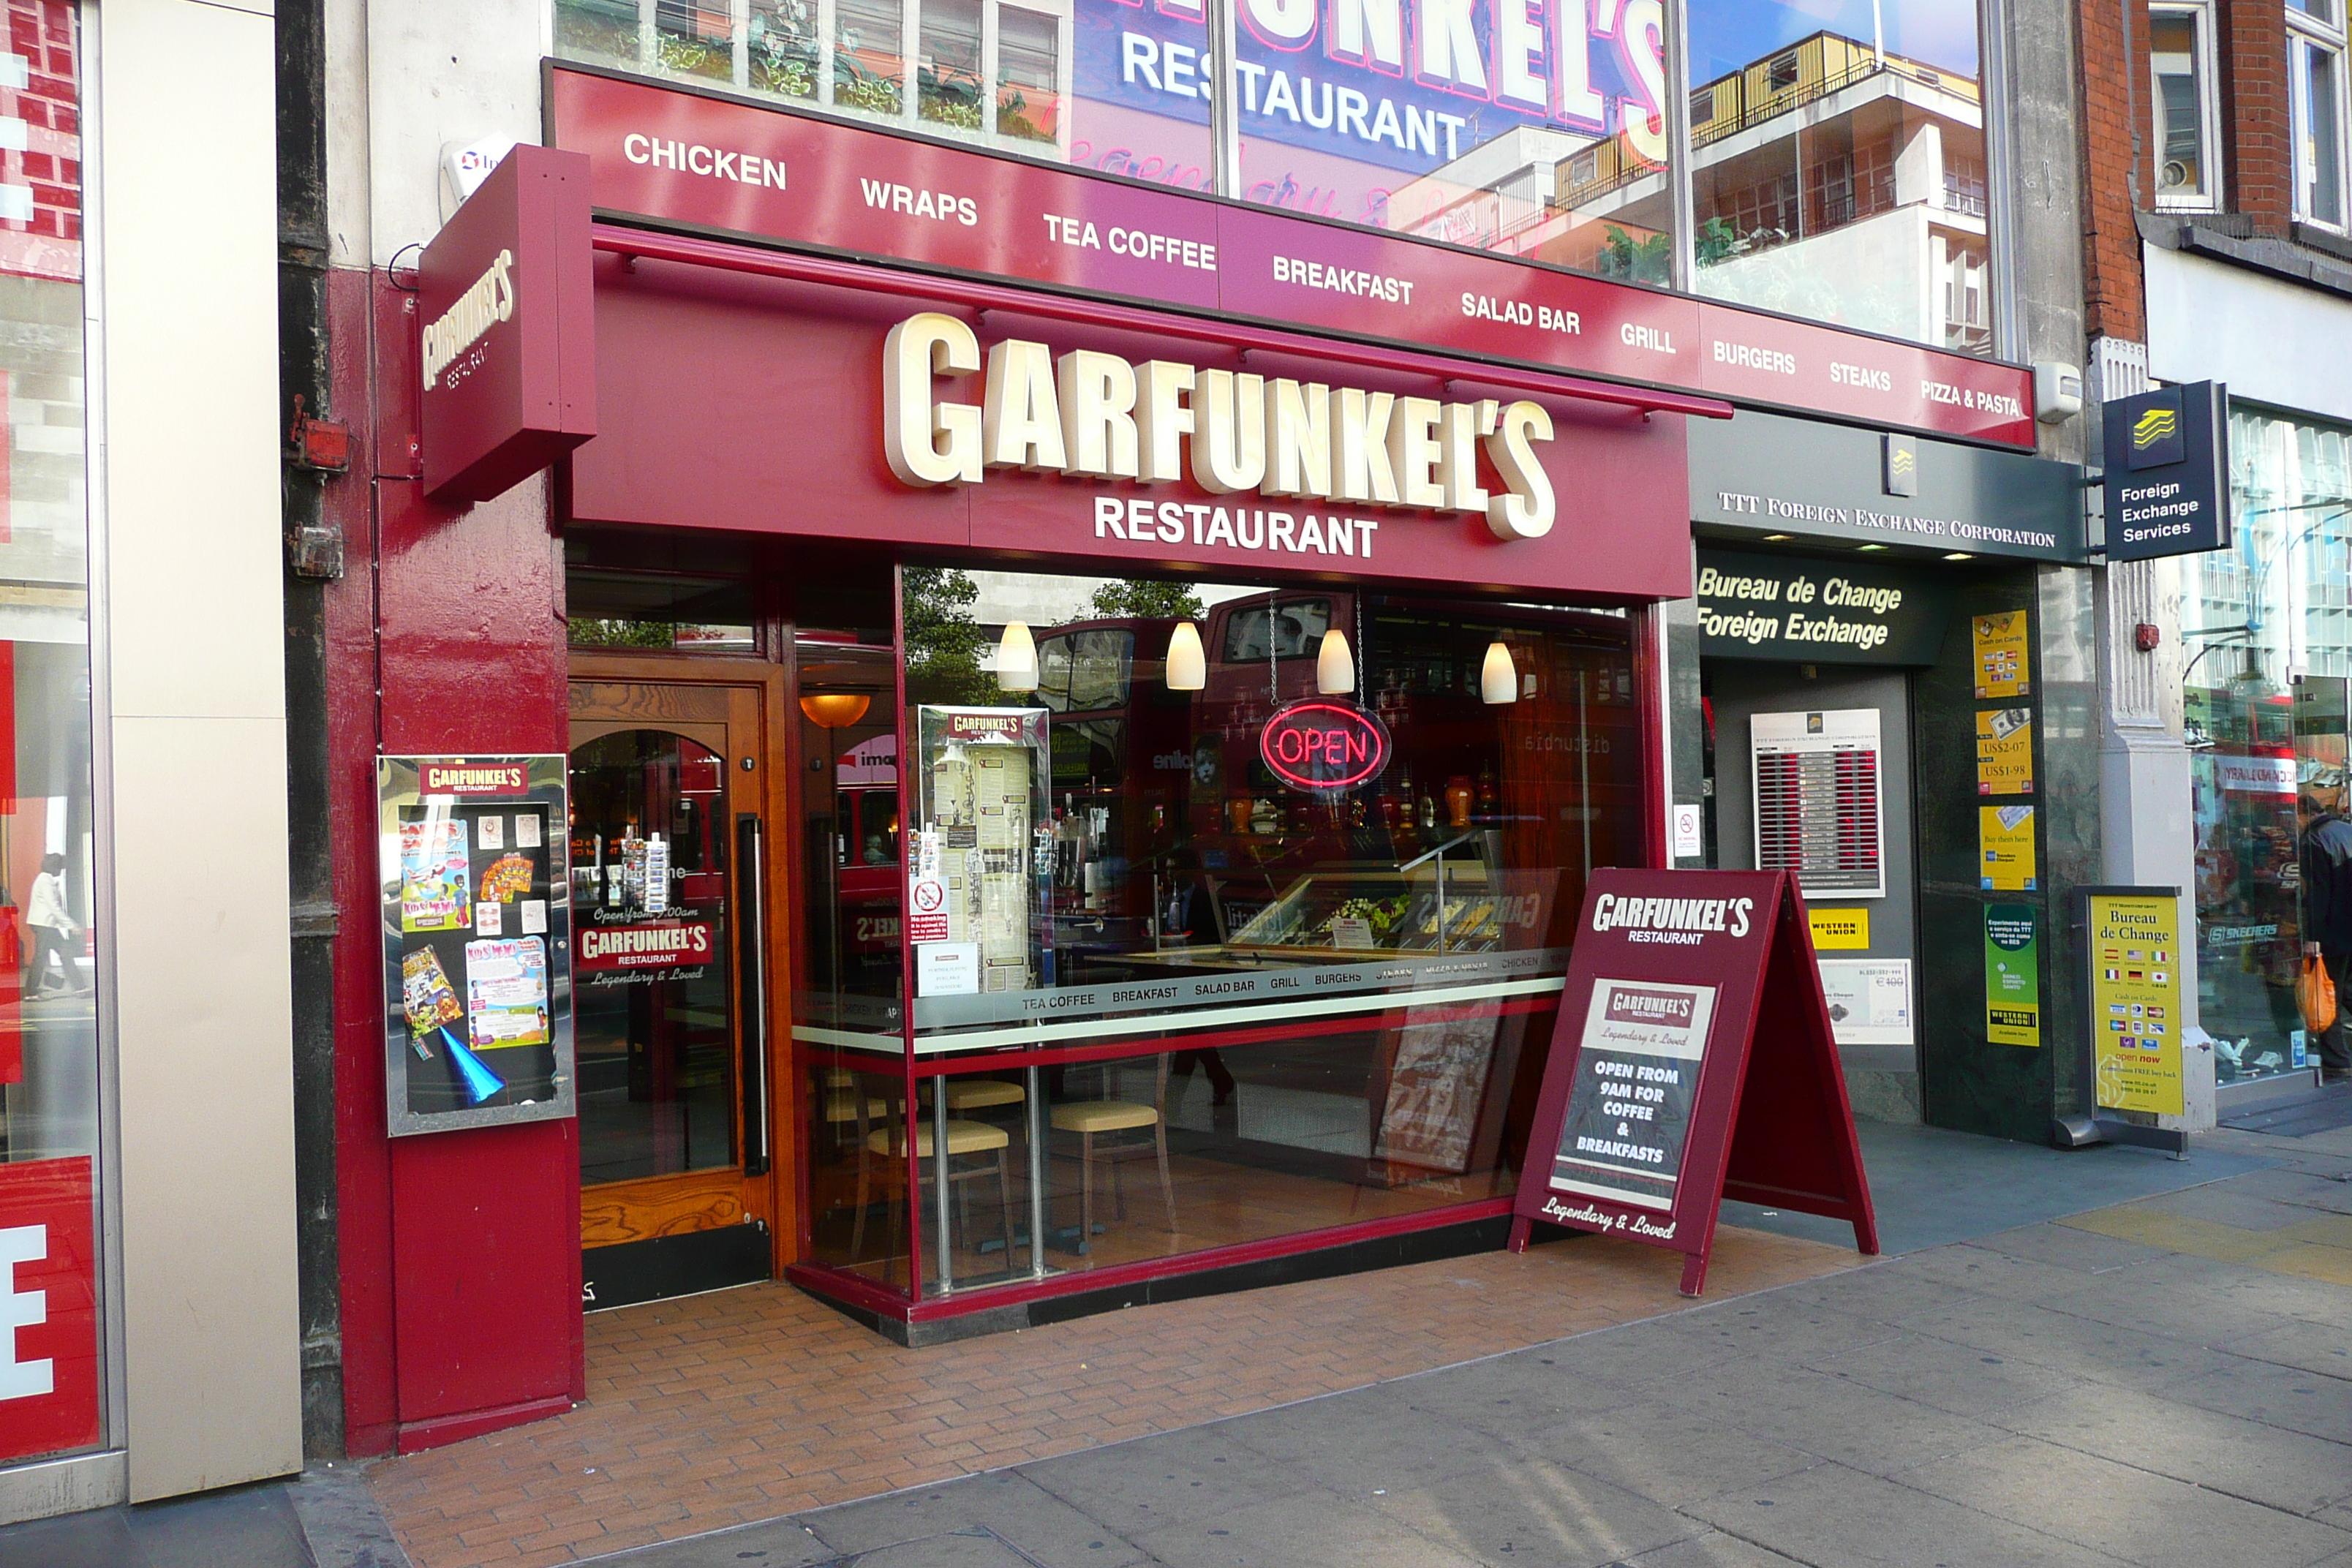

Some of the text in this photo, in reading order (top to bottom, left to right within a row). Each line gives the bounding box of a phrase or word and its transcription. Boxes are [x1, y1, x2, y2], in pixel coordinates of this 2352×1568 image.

[624, 133, 2019, 417] CHICKEN WRAPS TEA COFFEE BREAKFAST SALAD BAR GRILL BURGERS STEAKS PIZZA & PASTA
[423, 249, 513, 391] GARFUNKEL'S
[883, 312, 1556, 541] GARFUNKEL'S
[2122, 482, 2179, 503] Foreign
[1719, 491, 2056, 549] TTT FOREIGN EXCHANGE CORPORATION
[2122, 499, 2199, 522] Exchange
[1094, 497, 1379, 559] RESTAURANT
[2123, 521, 2191, 543] Services
[1698, 567, 1902, 614] Bureau de Change
[1697, 607, 1888, 651] Foreign Exchange
[1979, 638, 1994, 646] Cash
[2004, 636, 2023, 644] Cards
[954, 715, 1017, 733] GARFUNKEL'S
[1278, 728, 1367, 766] OPEN
[1984, 742, 2025, 754] US$2-07
[429, 768, 521, 788] GARFUNKEL'S
[1986, 765, 2025, 777] US$1-98
[594, 908, 624, 924] Open
[1593, 894, 1753, 938] GARFUNKEL'S
[2111, 911, 2157, 924] Bureau
[1628, 930, 1703, 945] RESTAURANT
[2100, 926, 2169, 943] de Change
[2225, 924, 2278, 939] SKECHERS
[582, 926, 706, 959] GARFUNKEL'S
[618, 954, 677, 965] RESTAURANT
[591, 966, 704, 989] Legendary & Loved
[1022, 999, 1046, 1011] TEA
[1049, 994, 1095, 1009] COFFEE
[1112, 987, 1178, 1003] BREAKFAST
[1194, 982, 1230, 995] SALAD
[1233, 981, 1255, 992] BAR
[1270, 976, 1300, 989] GRILL
[1315, 972, 1362, 985] BURGERS
[1501, 956, 1538, 969] CHICKEN
[1613, 992, 1690, 1017] GARFUNKEL'S
[1632, 1011, 1665, 1019] RESTAURANT
[1991, 1011, 2028, 1019] WESTERN
[1601, 1027, 1688, 1047] Legendary & Loved
[2116, 1053, 2160, 1064] open now
[1595, 1061, 1678, 1085] OPEN FROM
[1600, 1082, 1664, 1103] 9AM FOR
[1603, 1101, 1653, 1120] COFFEE
[1617, 1122, 1629, 1137] &
[1577, 1137, 1664, 1164] BREAKFASTS
[1542, 1197, 1676, 1240] Legendary & Loved
